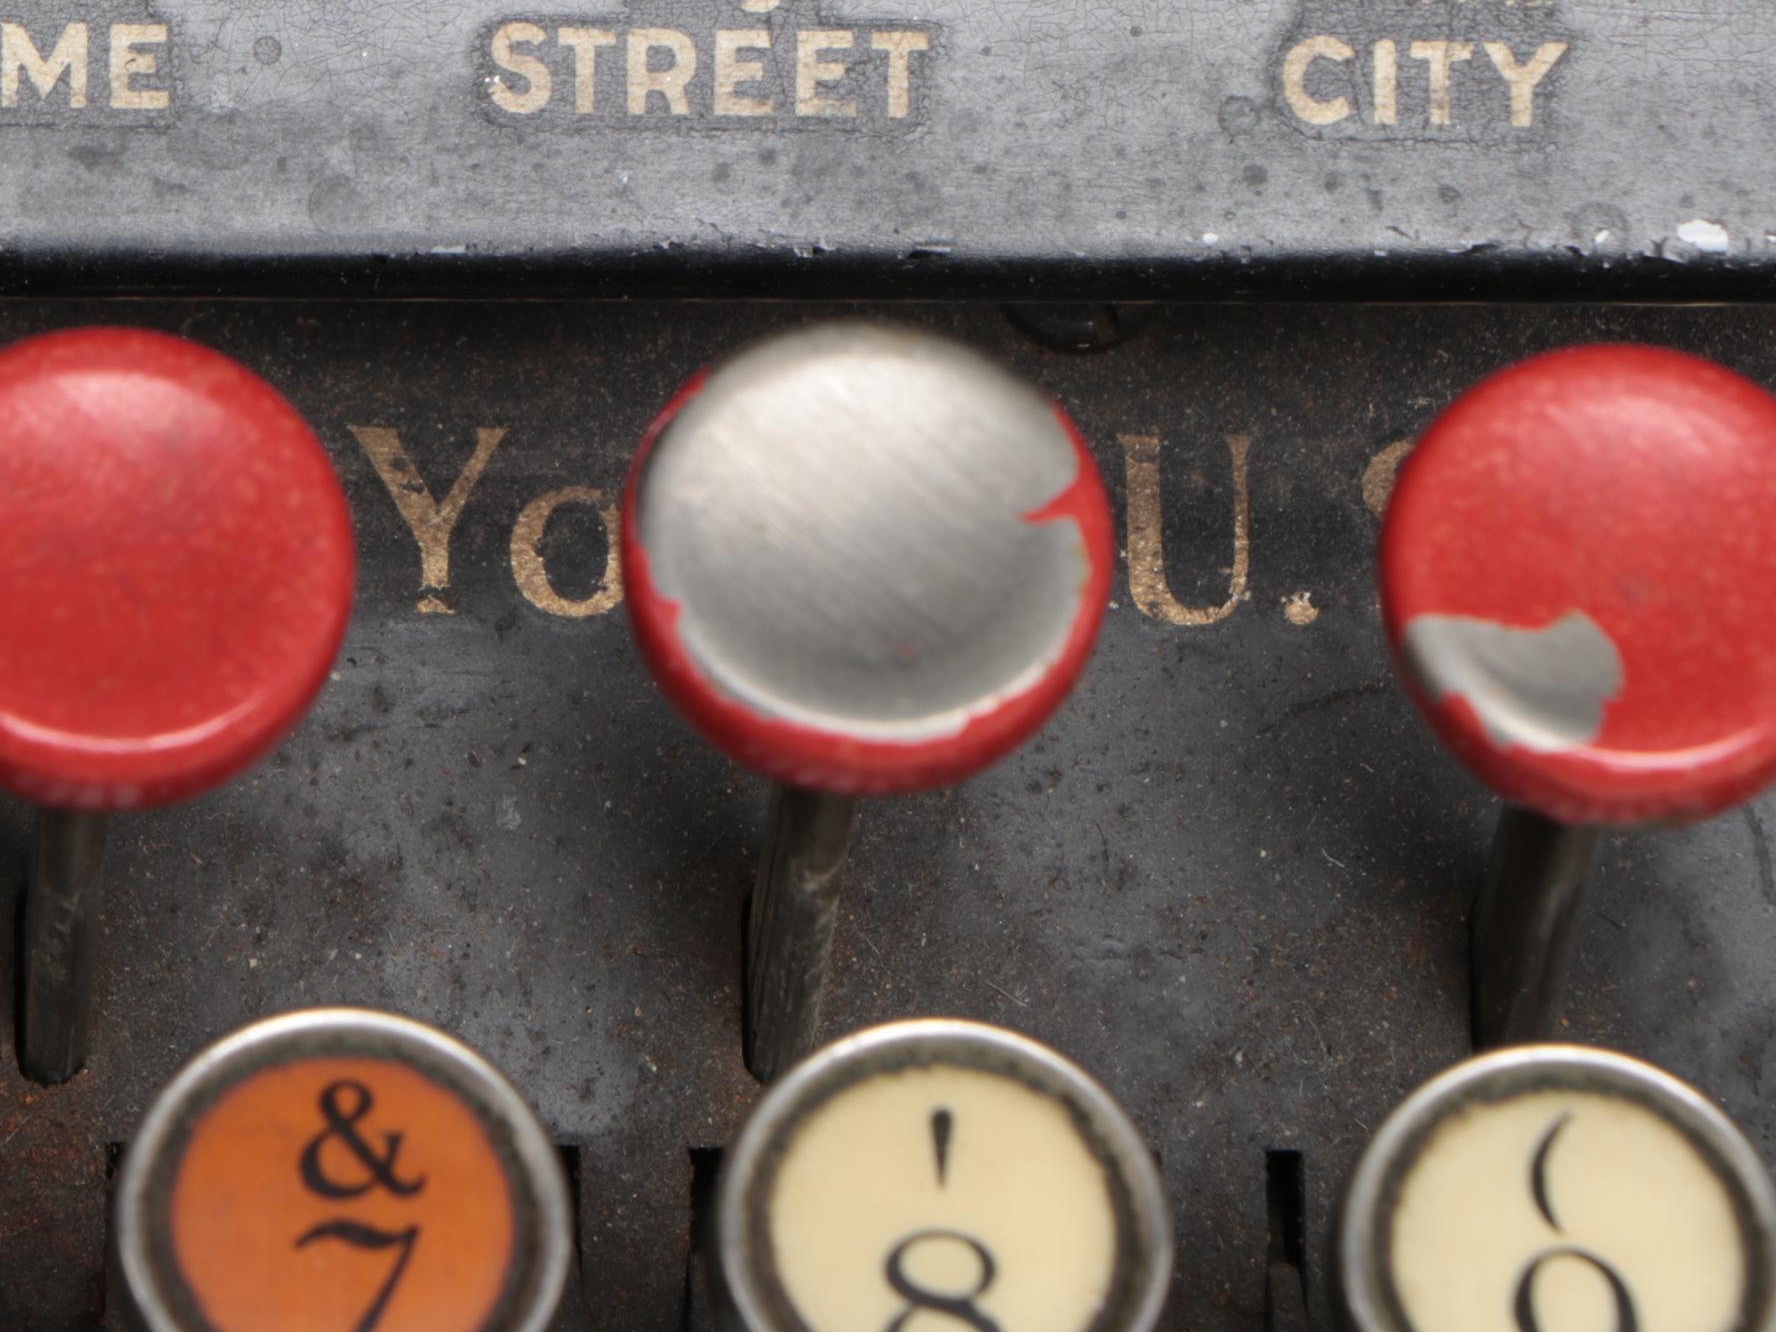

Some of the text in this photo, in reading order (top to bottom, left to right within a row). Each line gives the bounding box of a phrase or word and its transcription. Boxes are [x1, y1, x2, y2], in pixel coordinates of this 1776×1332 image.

[488, 22, 930, 119] STREET
[1282, 33, 1570, 128] CITY
[298, 1078, 427, 1201] &
[294, 1218, 420, 1332] 7
